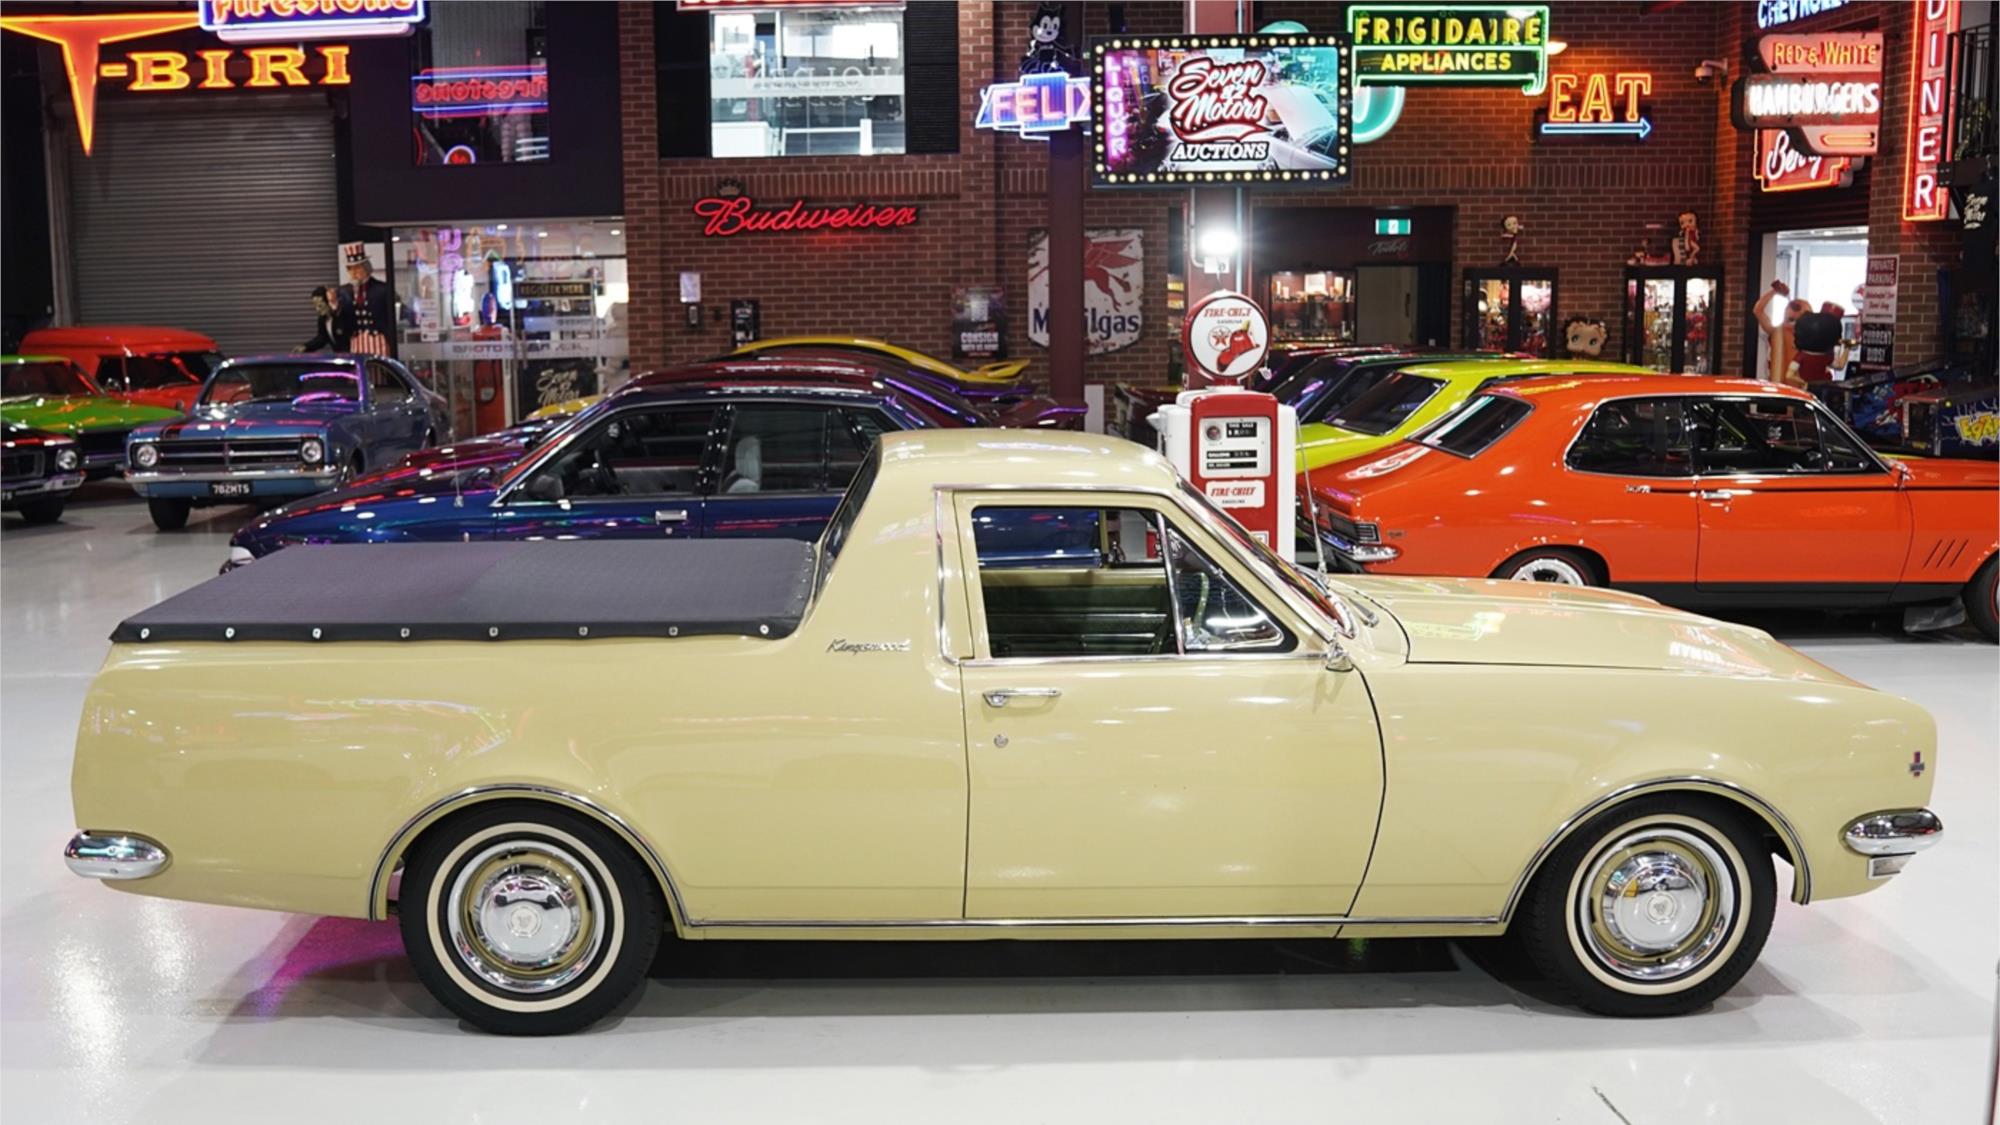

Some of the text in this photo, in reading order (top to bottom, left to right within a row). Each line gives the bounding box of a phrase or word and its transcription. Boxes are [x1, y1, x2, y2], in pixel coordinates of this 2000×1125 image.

[1354, 16, 1541, 45] FRIGIDAIRE
[1757, 0, 1848, 29] CHEVRO
[1380, 52, 1512, 72] APPLIANCES
[1774, 41, 1878, 66] RED & WHITE
[1172, 58, 1262, 94] Seven
[992, 83, 1091, 124] FELIX
[1174, 93, 1263, 127] Motors
[1549, 73, 1651, 122] EAT
[1749, 82, 1880, 116] HAMBURGERS
[1913, 0, 1946, 209] DINER
[1172, 143, 1267, 160] AUCTIONS
[694, 197, 917, 237] Budweiser
[1033, 307, 1140, 340] Milgas
[1211, 487, 1256, 497] FIRE-CHIEF
